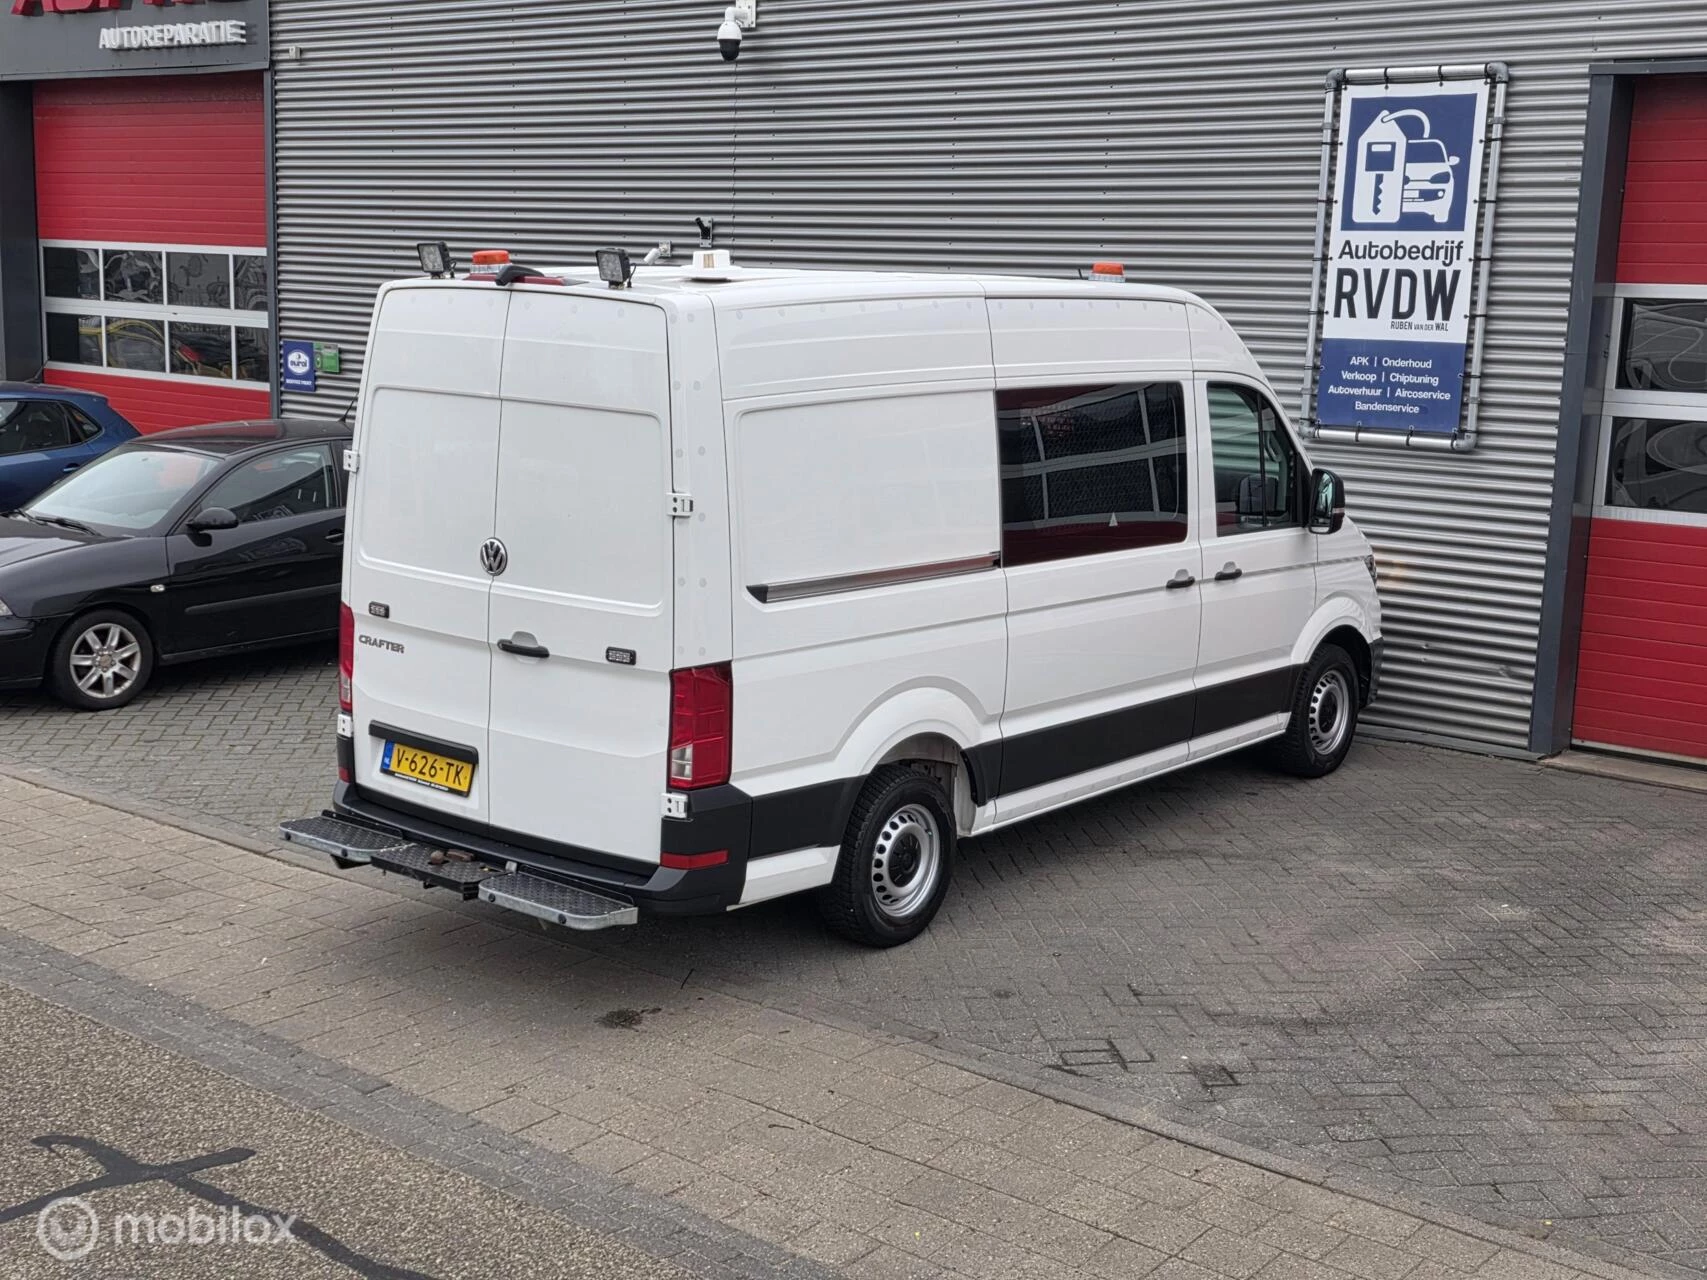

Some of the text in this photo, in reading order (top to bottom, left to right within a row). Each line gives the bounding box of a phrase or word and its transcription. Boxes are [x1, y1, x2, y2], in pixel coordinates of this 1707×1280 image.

[99, 20, 247, 49] AUTOREPARATIE
[1338, 240, 1464, 267] Autobedrijf
[1333, 267, 1462, 321] RVDW
[1390, 320, 1413, 330] RUBEN
[1350, 356, 1369, 366] APK
[1382, 357, 1432, 369] Onderhoud
[1341, 370, 1377, 382] Verkoop
[1389, 372, 1439, 386] Chiptuning
[1328, 385, 1382, 396] Autoverhuur
[1395, 388, 1451, 400] Aircoservice
[1355, 401, 1420, 413] Bandenservice
[358, 634, 405, 654] CRAFTER
[396, 747, 465, 786] V-626-TK
